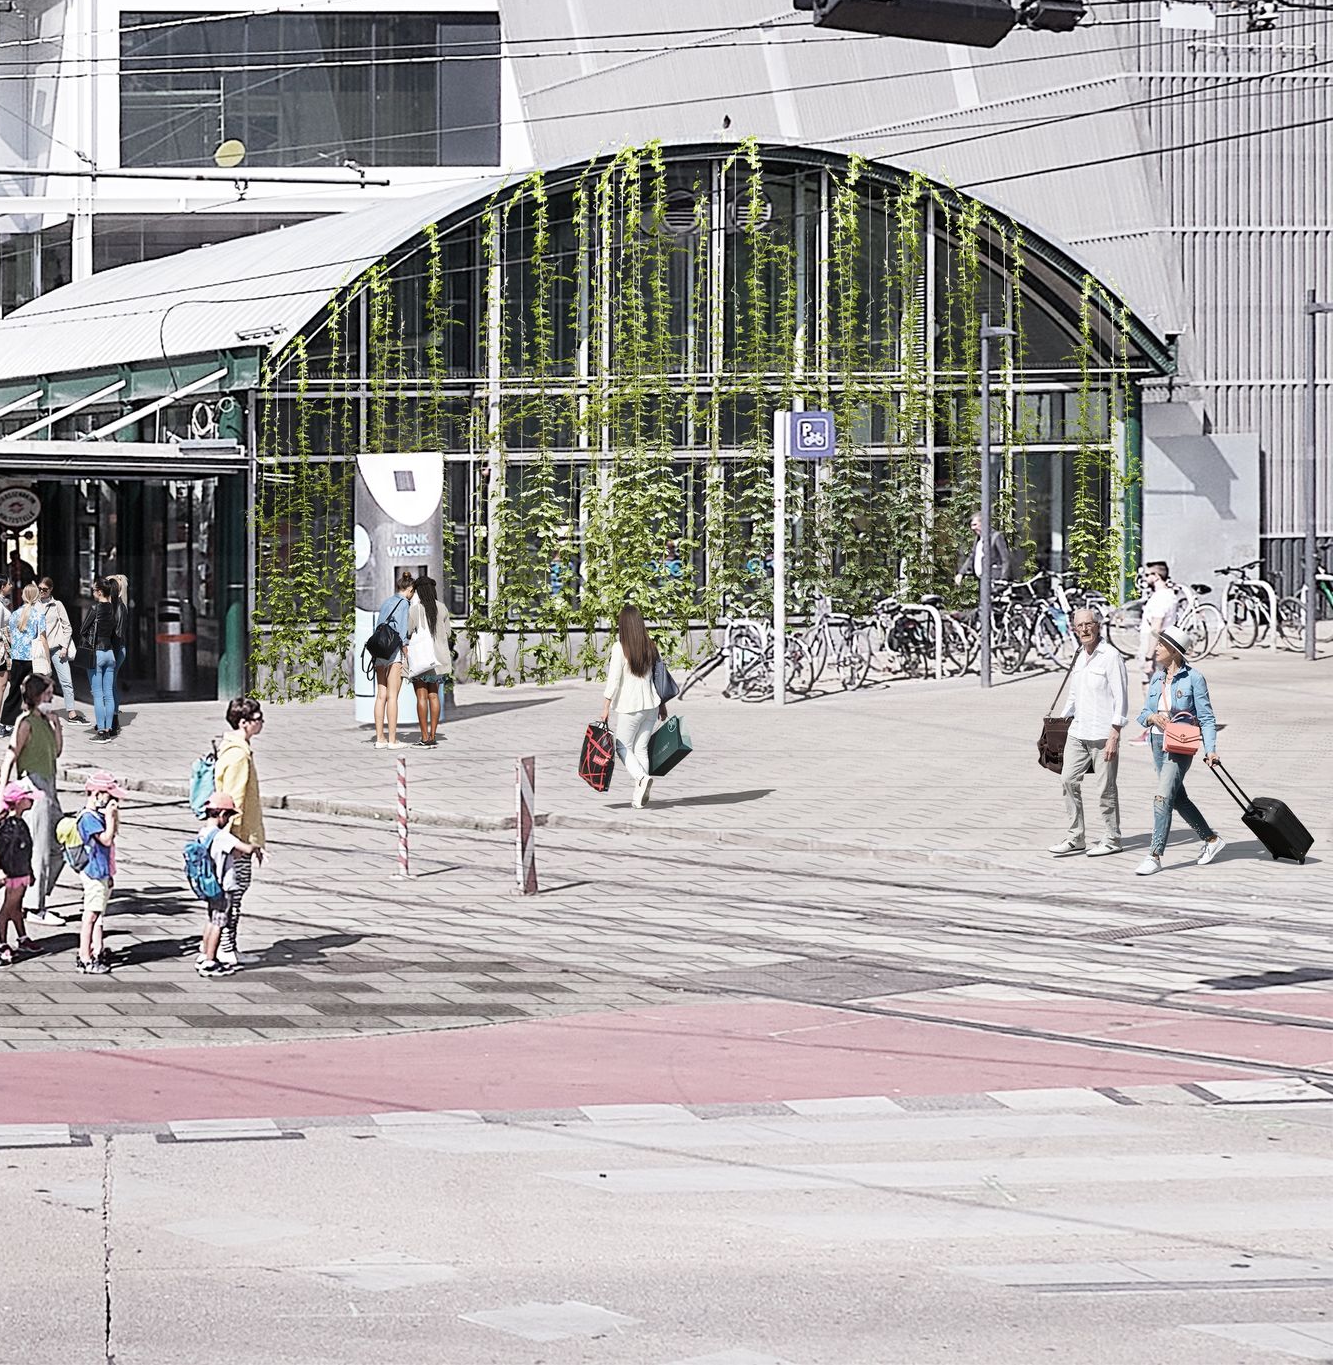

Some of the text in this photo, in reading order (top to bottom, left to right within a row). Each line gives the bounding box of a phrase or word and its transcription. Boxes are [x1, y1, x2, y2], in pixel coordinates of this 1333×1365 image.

[802, 422, 812, 437] P
[395, 533, 429, 545] TRINK
[387, 545, 433, 556] WASSER
